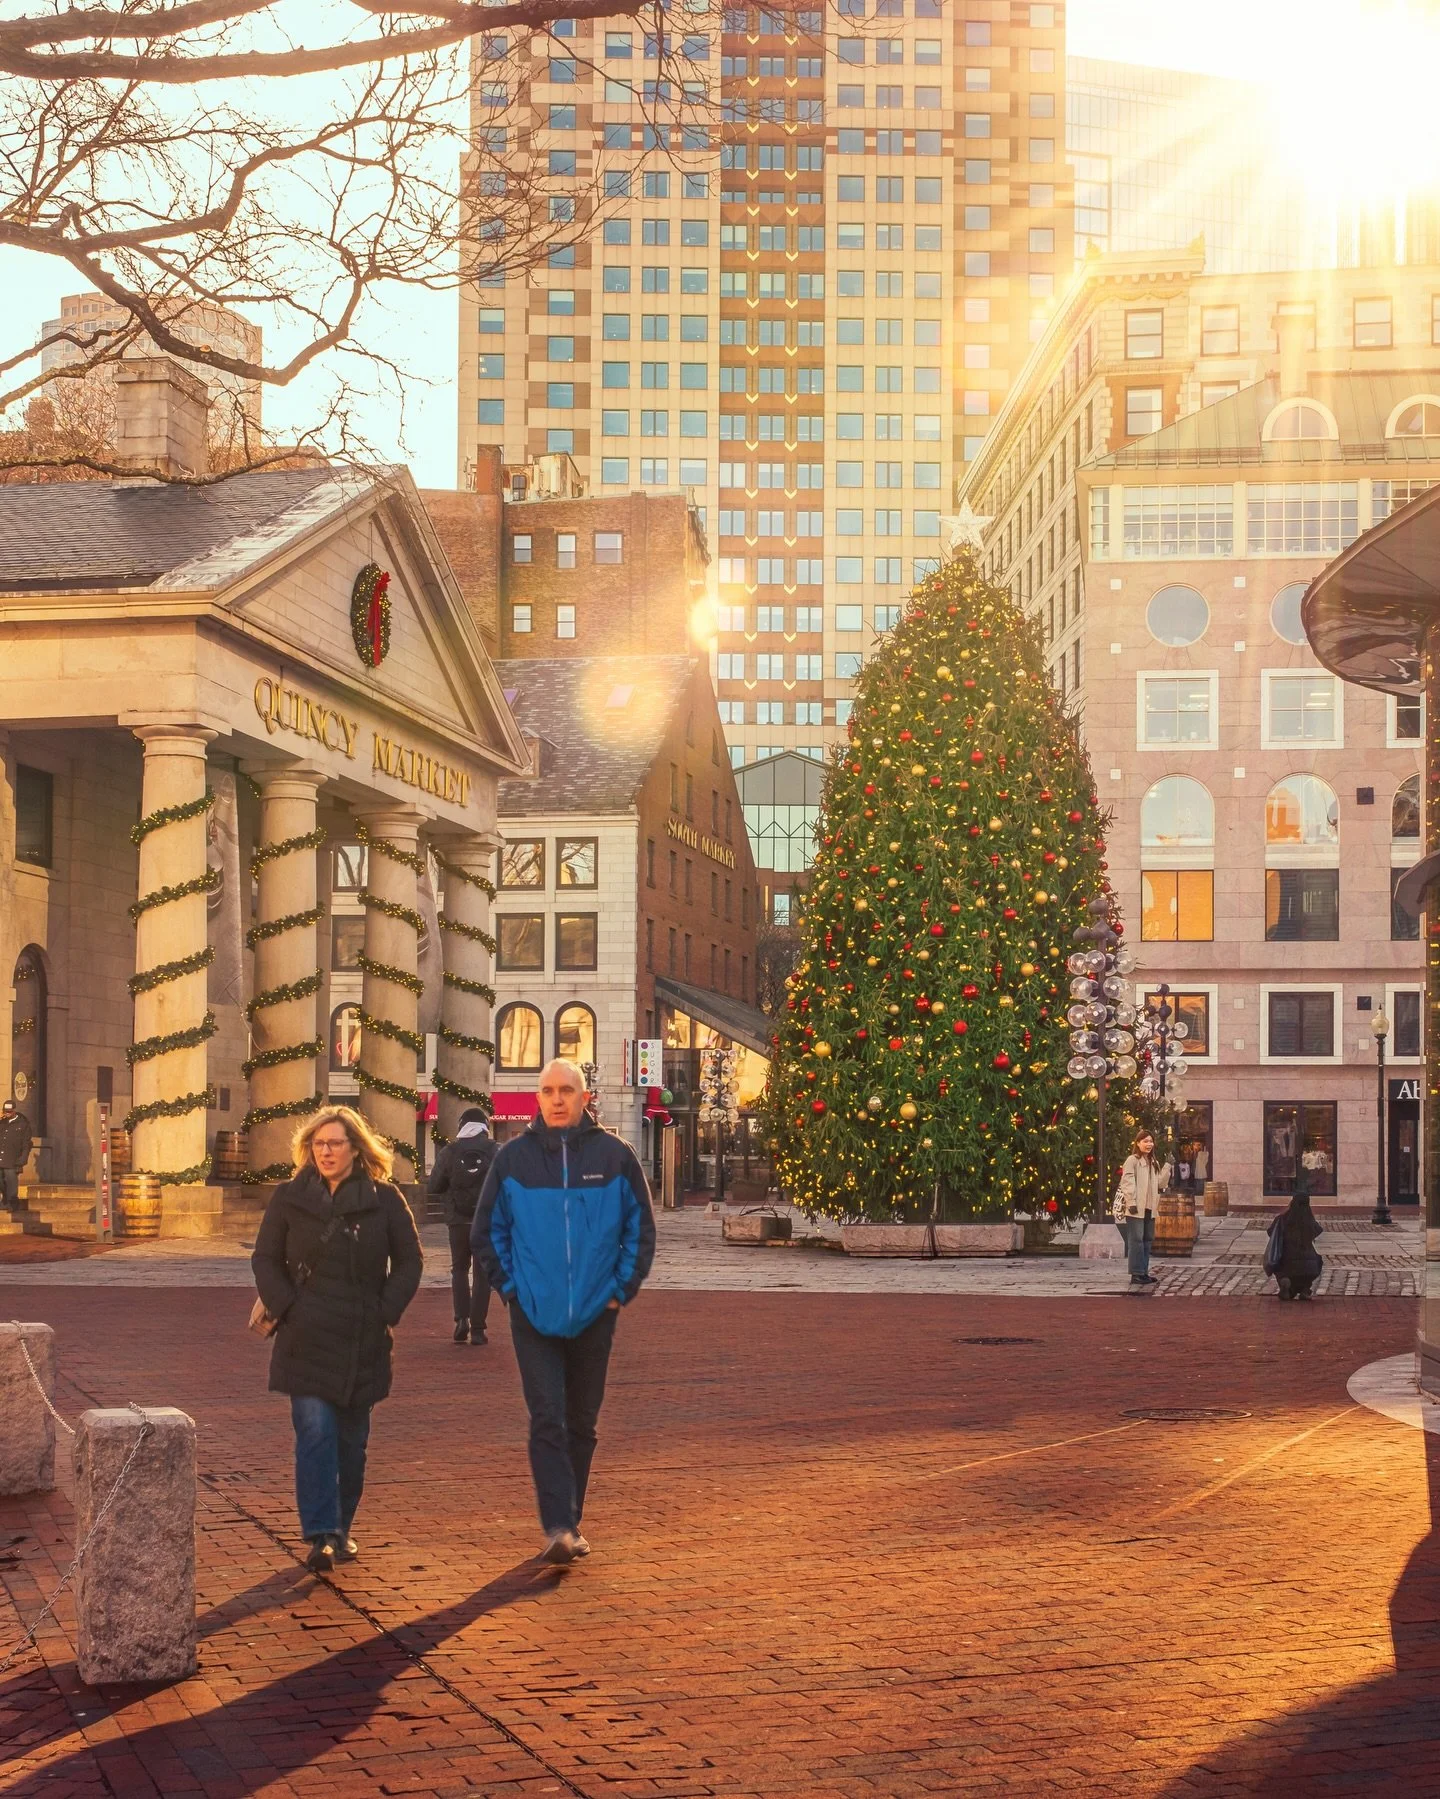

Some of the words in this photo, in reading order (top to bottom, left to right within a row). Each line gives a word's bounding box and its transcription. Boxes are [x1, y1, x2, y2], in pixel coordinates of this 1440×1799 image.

[254, 676, 359, 760] QUINCY
[373, 732, 471, 808] MARKET
[667, 817, 698, 850] SOUTH
[701, 835, 737, 870] MARKET
